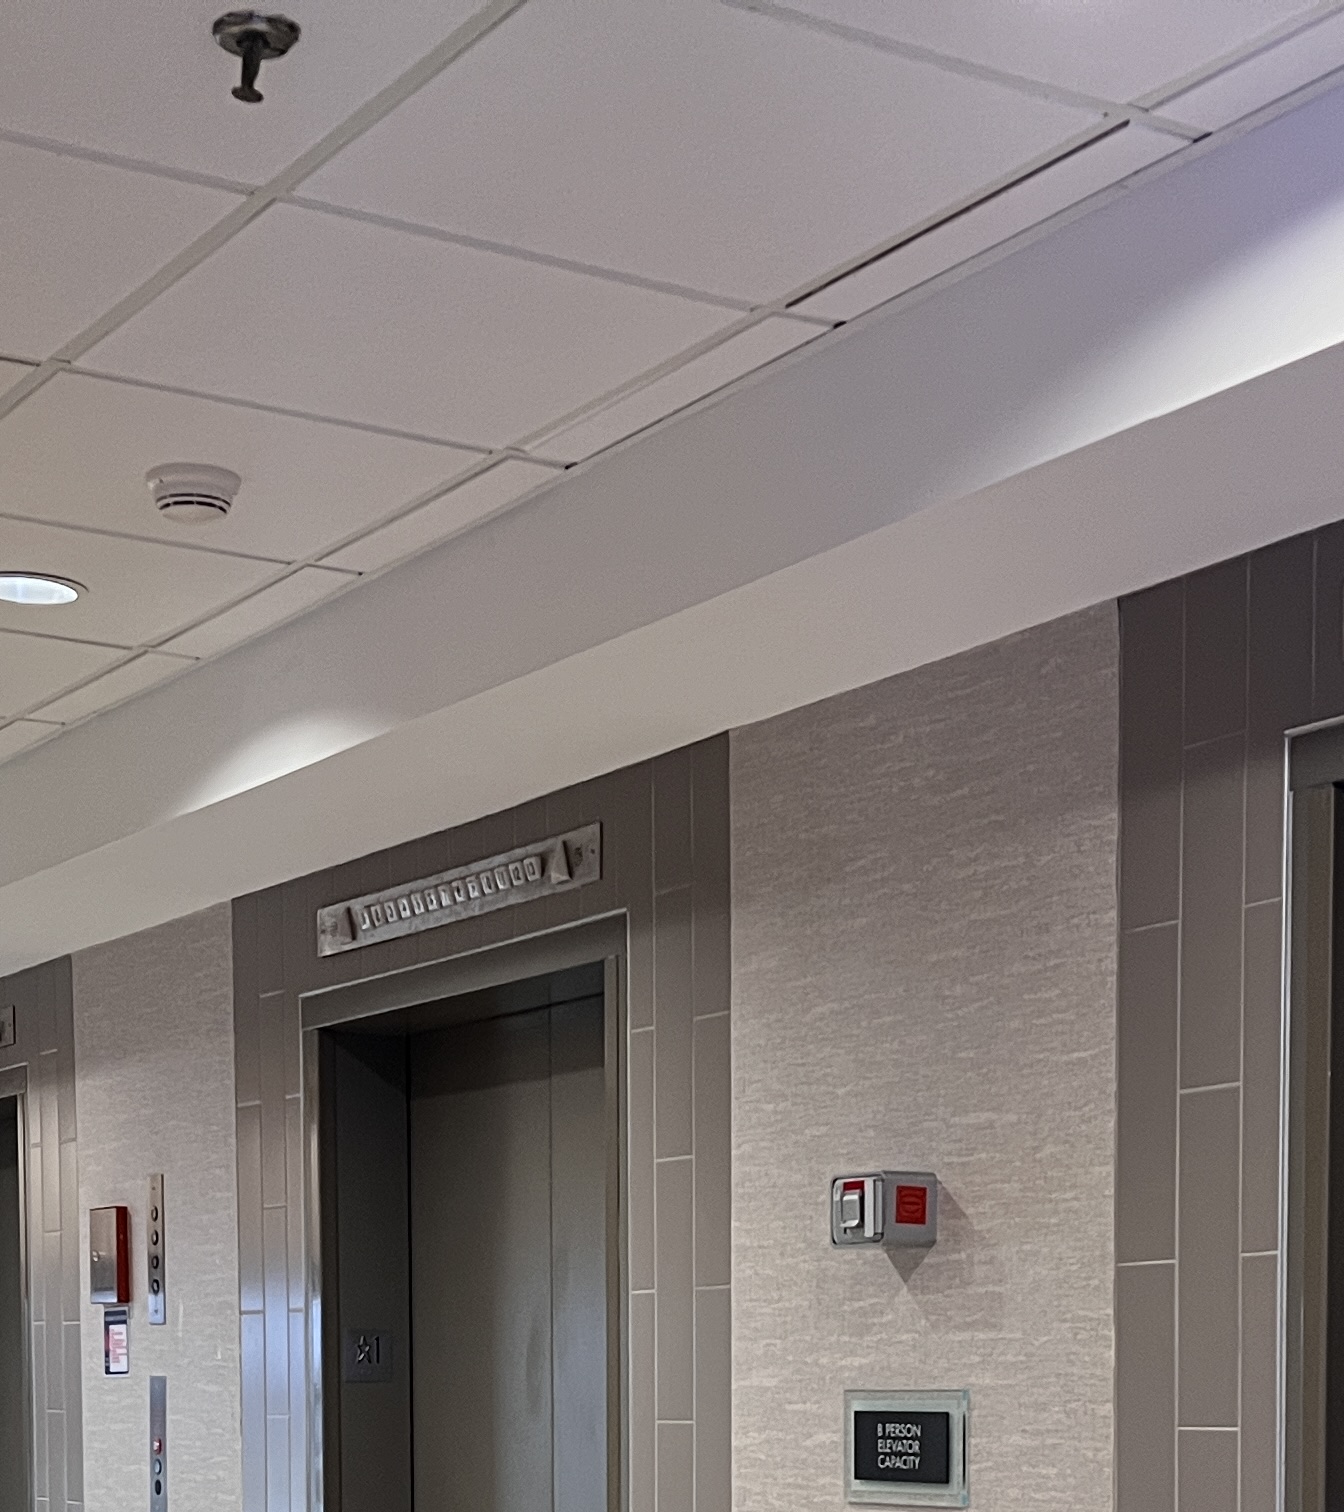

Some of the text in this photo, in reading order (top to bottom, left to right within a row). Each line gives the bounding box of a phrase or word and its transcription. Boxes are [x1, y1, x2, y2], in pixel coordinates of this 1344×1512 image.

[374, 1336, 380, 1364] 1
[885, 1423, 922, 1438] PERSON
[877, 1439, 921, 1453] ELEVATOR
[877, 1455, 920, 1469] CAPACITY
